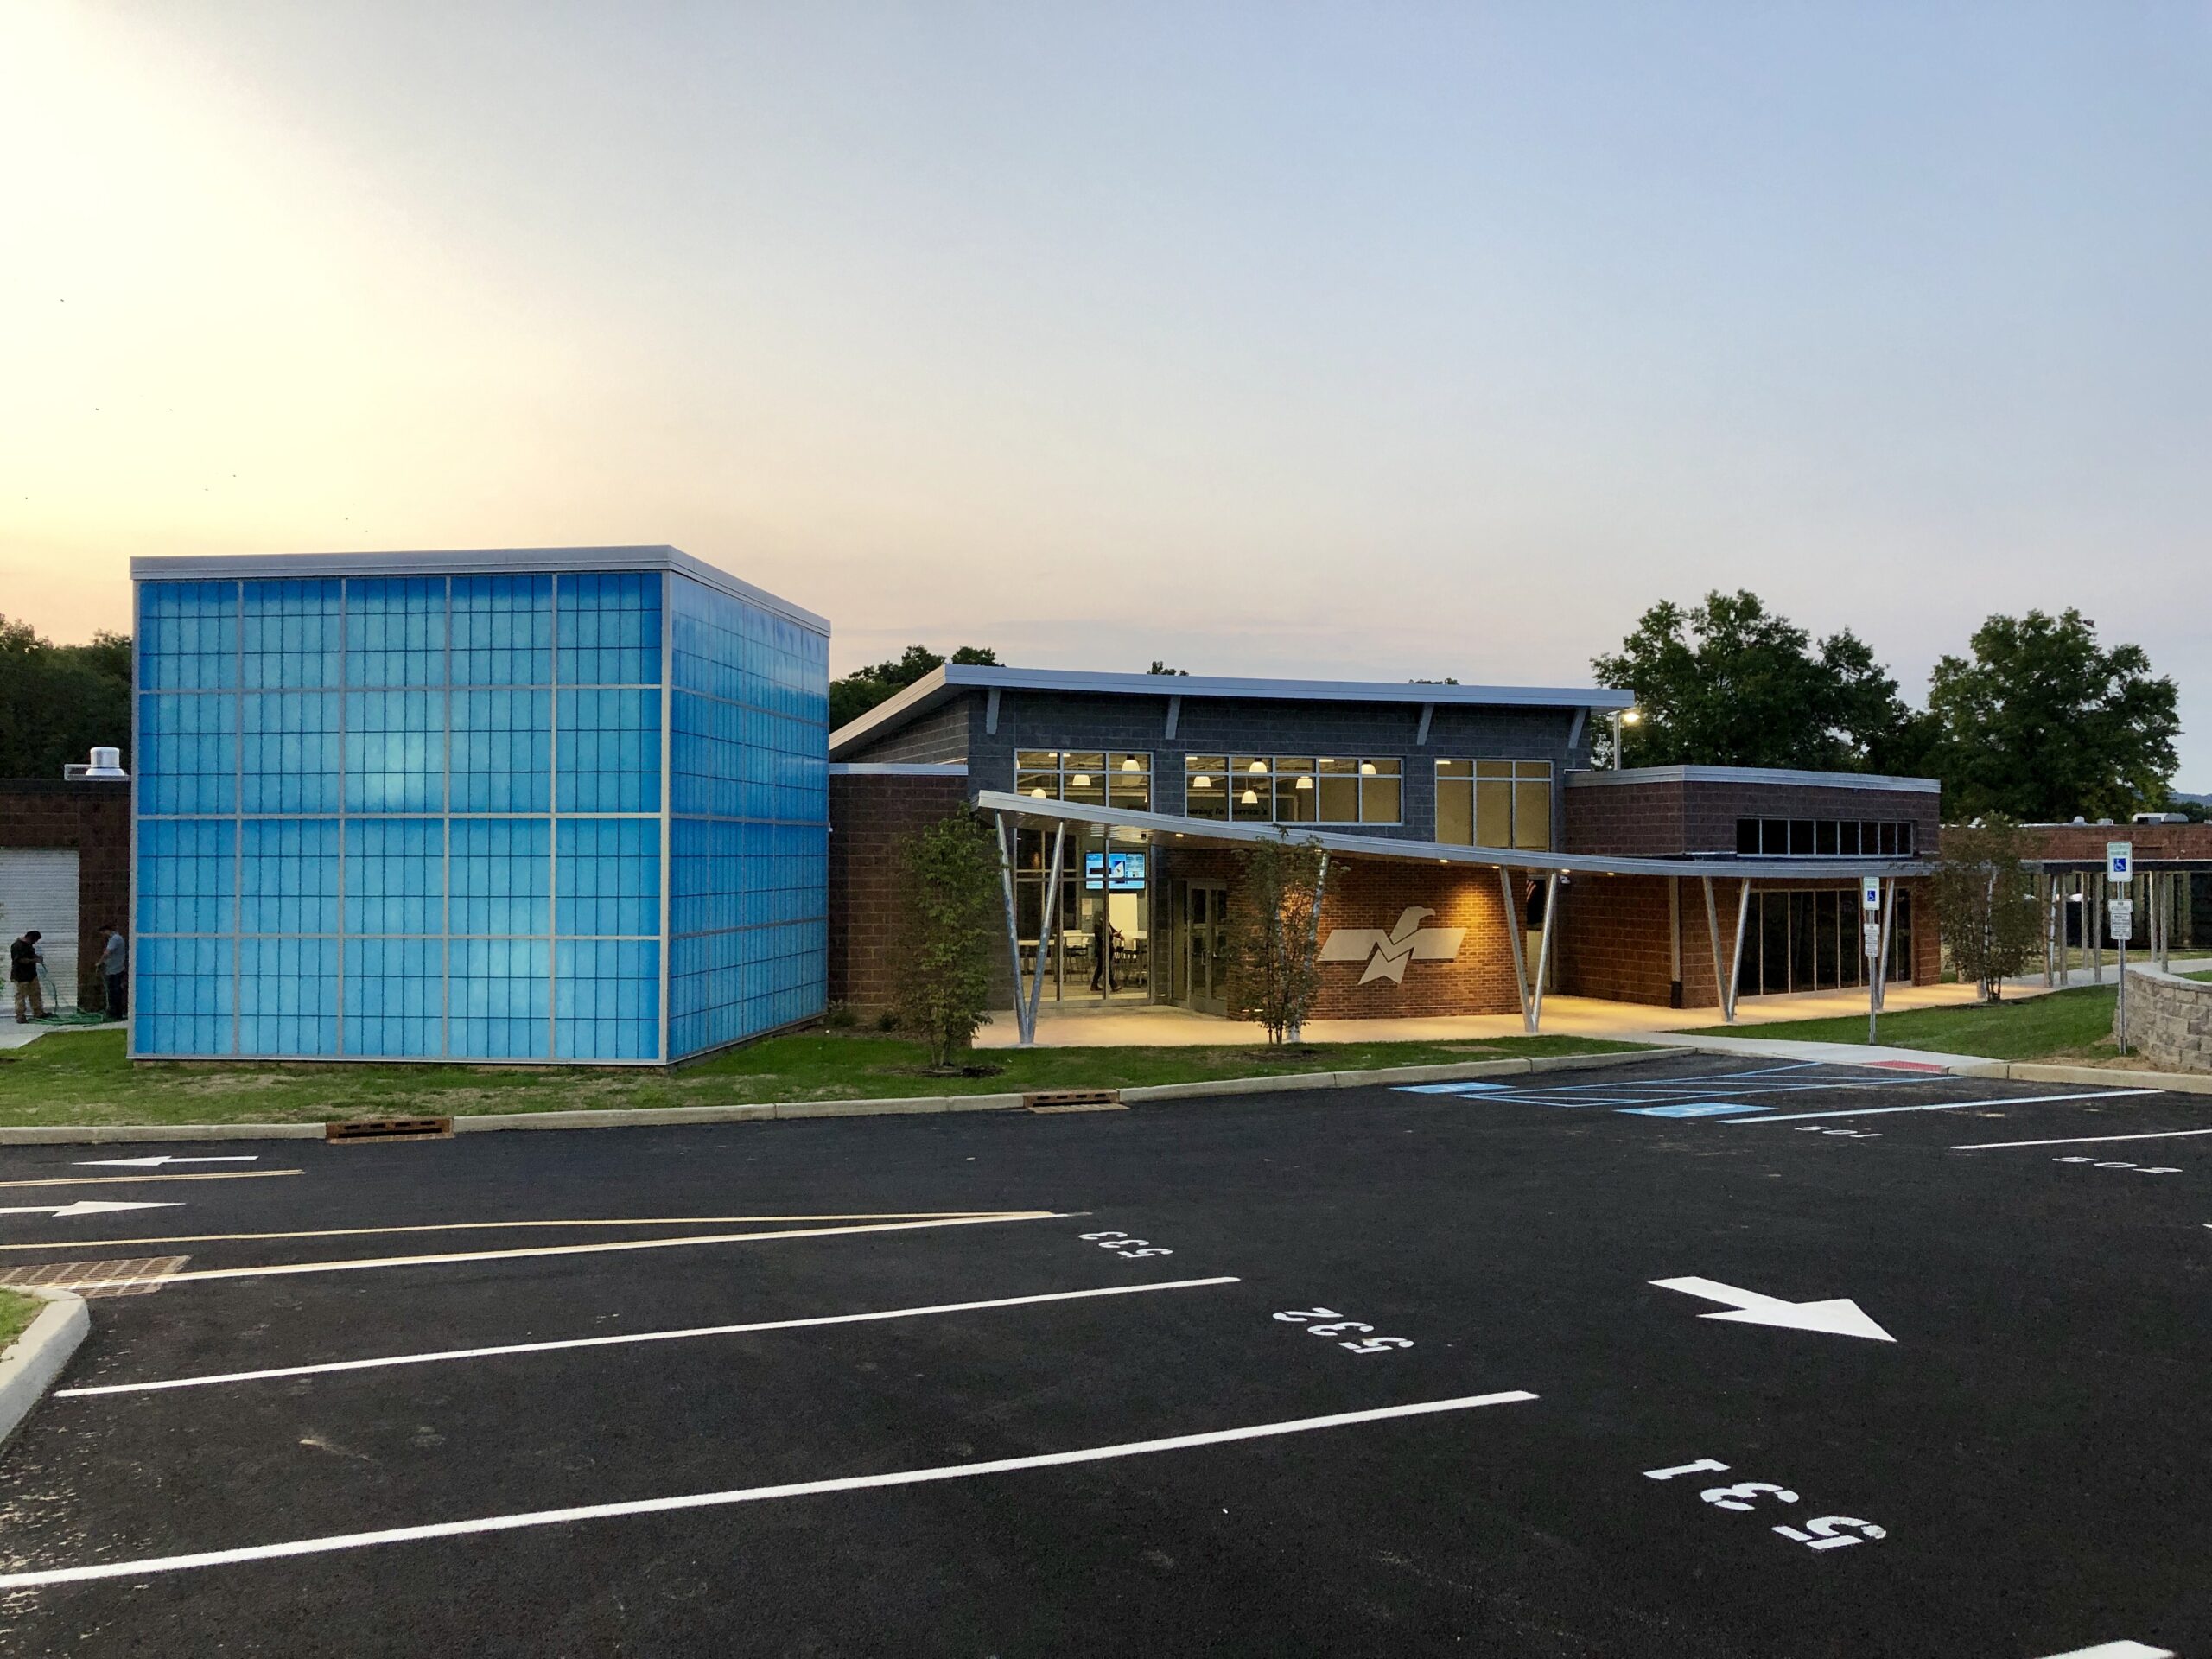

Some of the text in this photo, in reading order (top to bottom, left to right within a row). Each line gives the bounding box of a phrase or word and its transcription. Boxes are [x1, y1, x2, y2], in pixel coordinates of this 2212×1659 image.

[1795, 1125, 1884, 1138] 501
[2051, 1156, 2183, 1174] 502
[1077, 1231, 1174, 1259] 533
[1272, 1307, 1414, 1354] 532
[1643, 1459, 1887, 1550] 531
